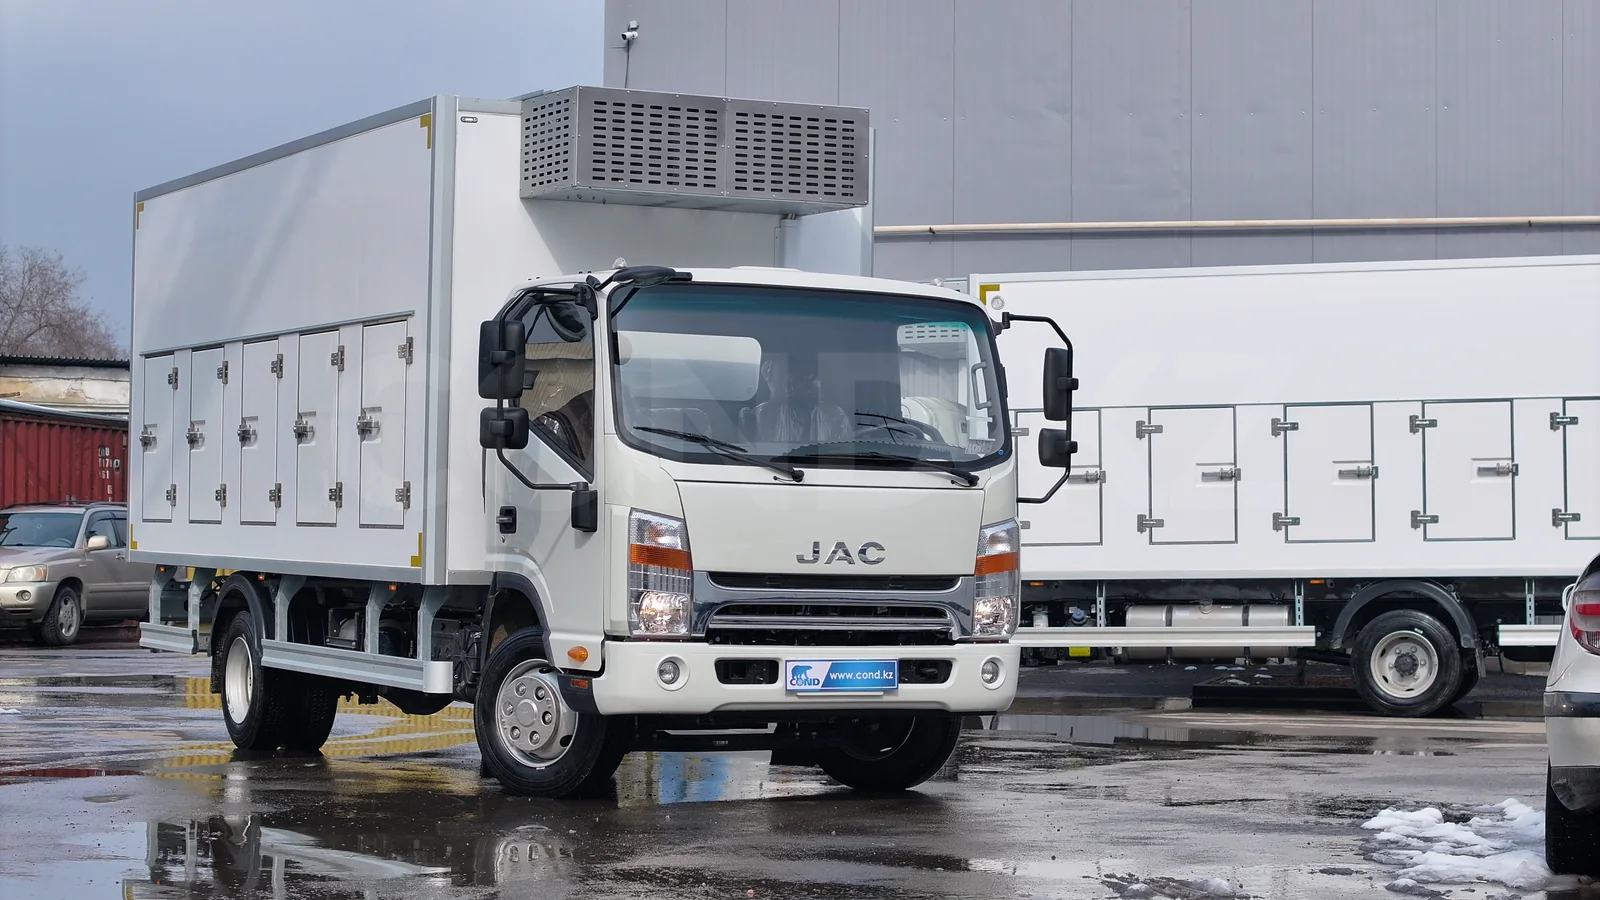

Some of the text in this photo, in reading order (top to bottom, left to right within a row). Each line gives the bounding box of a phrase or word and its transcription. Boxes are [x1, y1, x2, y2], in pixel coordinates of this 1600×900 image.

[796, 541, 886, 565] JAC
[829, 669, 894, 680] www.cond.kz
[790, 677, 820, 687] COND
